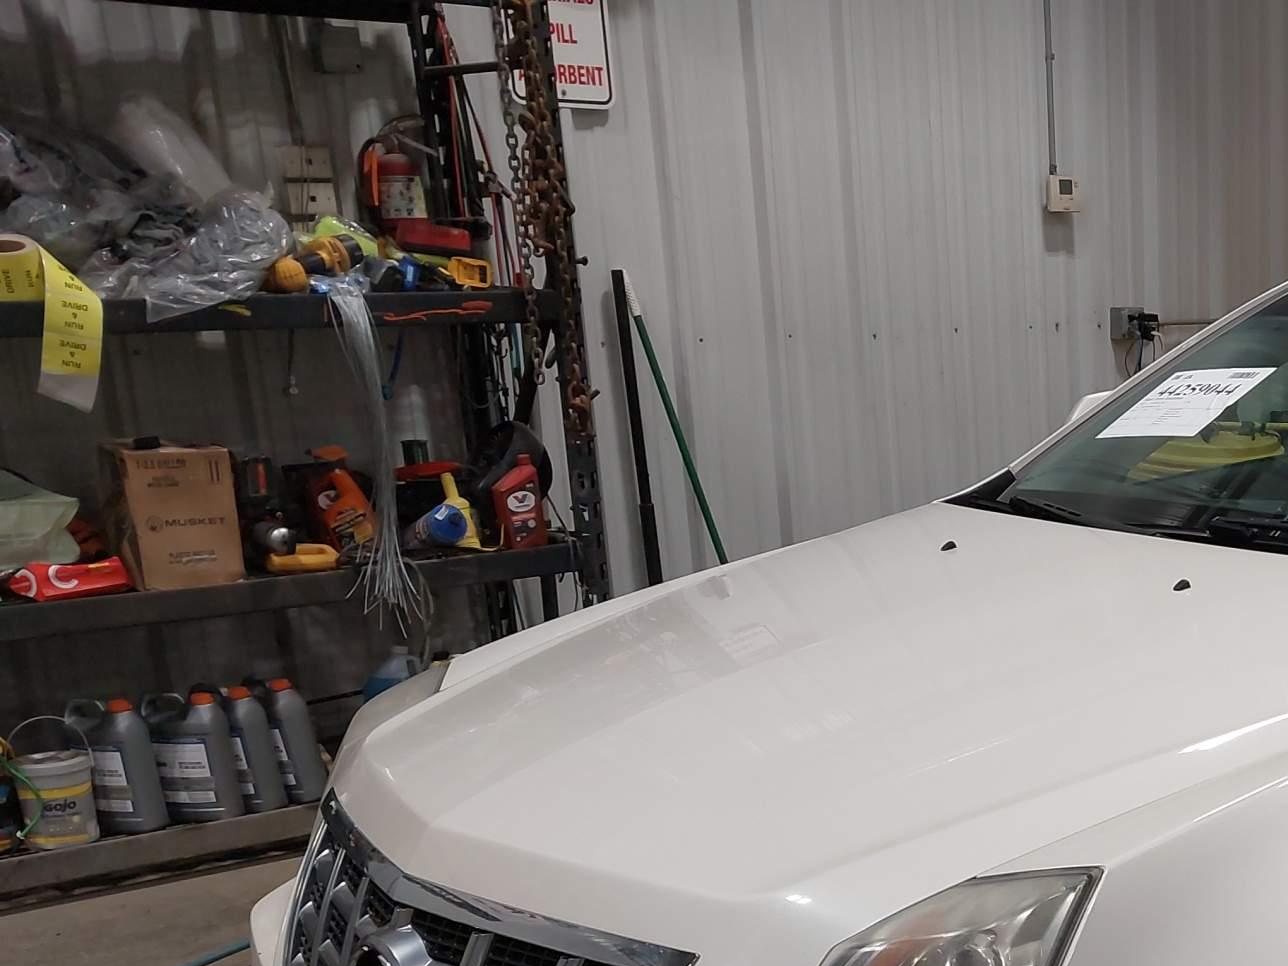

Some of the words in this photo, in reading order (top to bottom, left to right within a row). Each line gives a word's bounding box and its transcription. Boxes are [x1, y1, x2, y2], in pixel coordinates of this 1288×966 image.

[549, 23, 578, 44] PILL
[62, 301, 88, 311] DRIVE
[64, 321, 83, 330] RUN
[59, 340, 86, 351] DRIVE
[62, 360, 81, 369] RUN
[1158, 383, 1243, 396] 44259044
[165, 516, 225, 528] MUSKET
